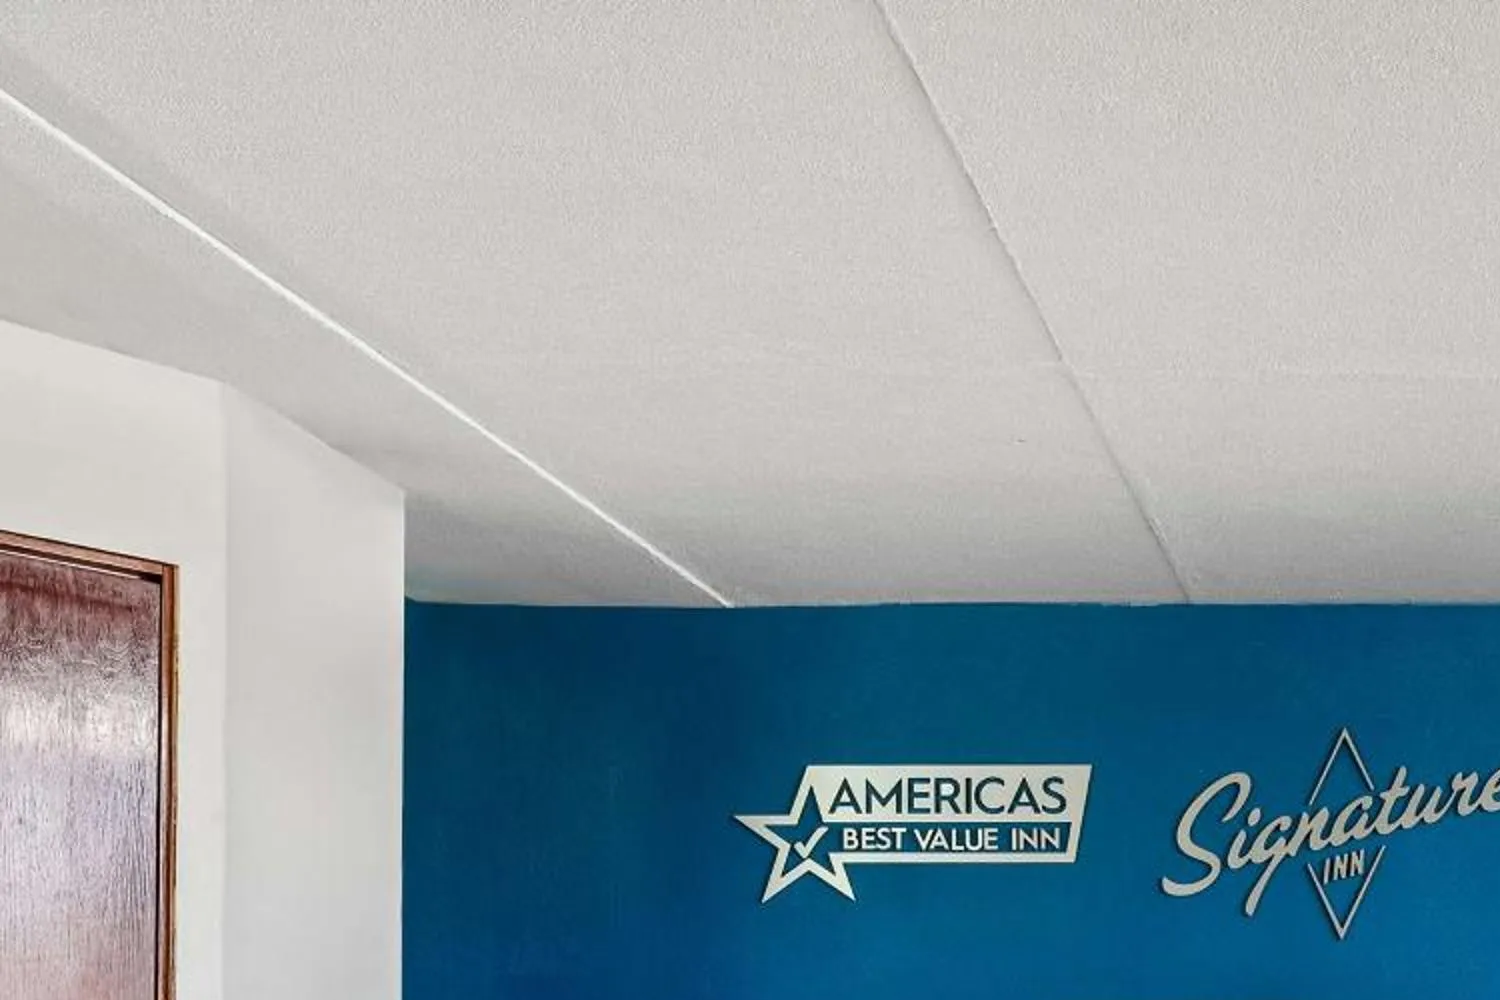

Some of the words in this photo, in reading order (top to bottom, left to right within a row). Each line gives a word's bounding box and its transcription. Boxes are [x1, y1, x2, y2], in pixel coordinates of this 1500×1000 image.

[828, 776, 1068, 815] AMERICAS
[842, 827, 907, 850] BEST
[914, 827, 999, 850] VALUE
[1011, 827, 1062, 850] INN
[1322, 848, 1366, 885] INN
